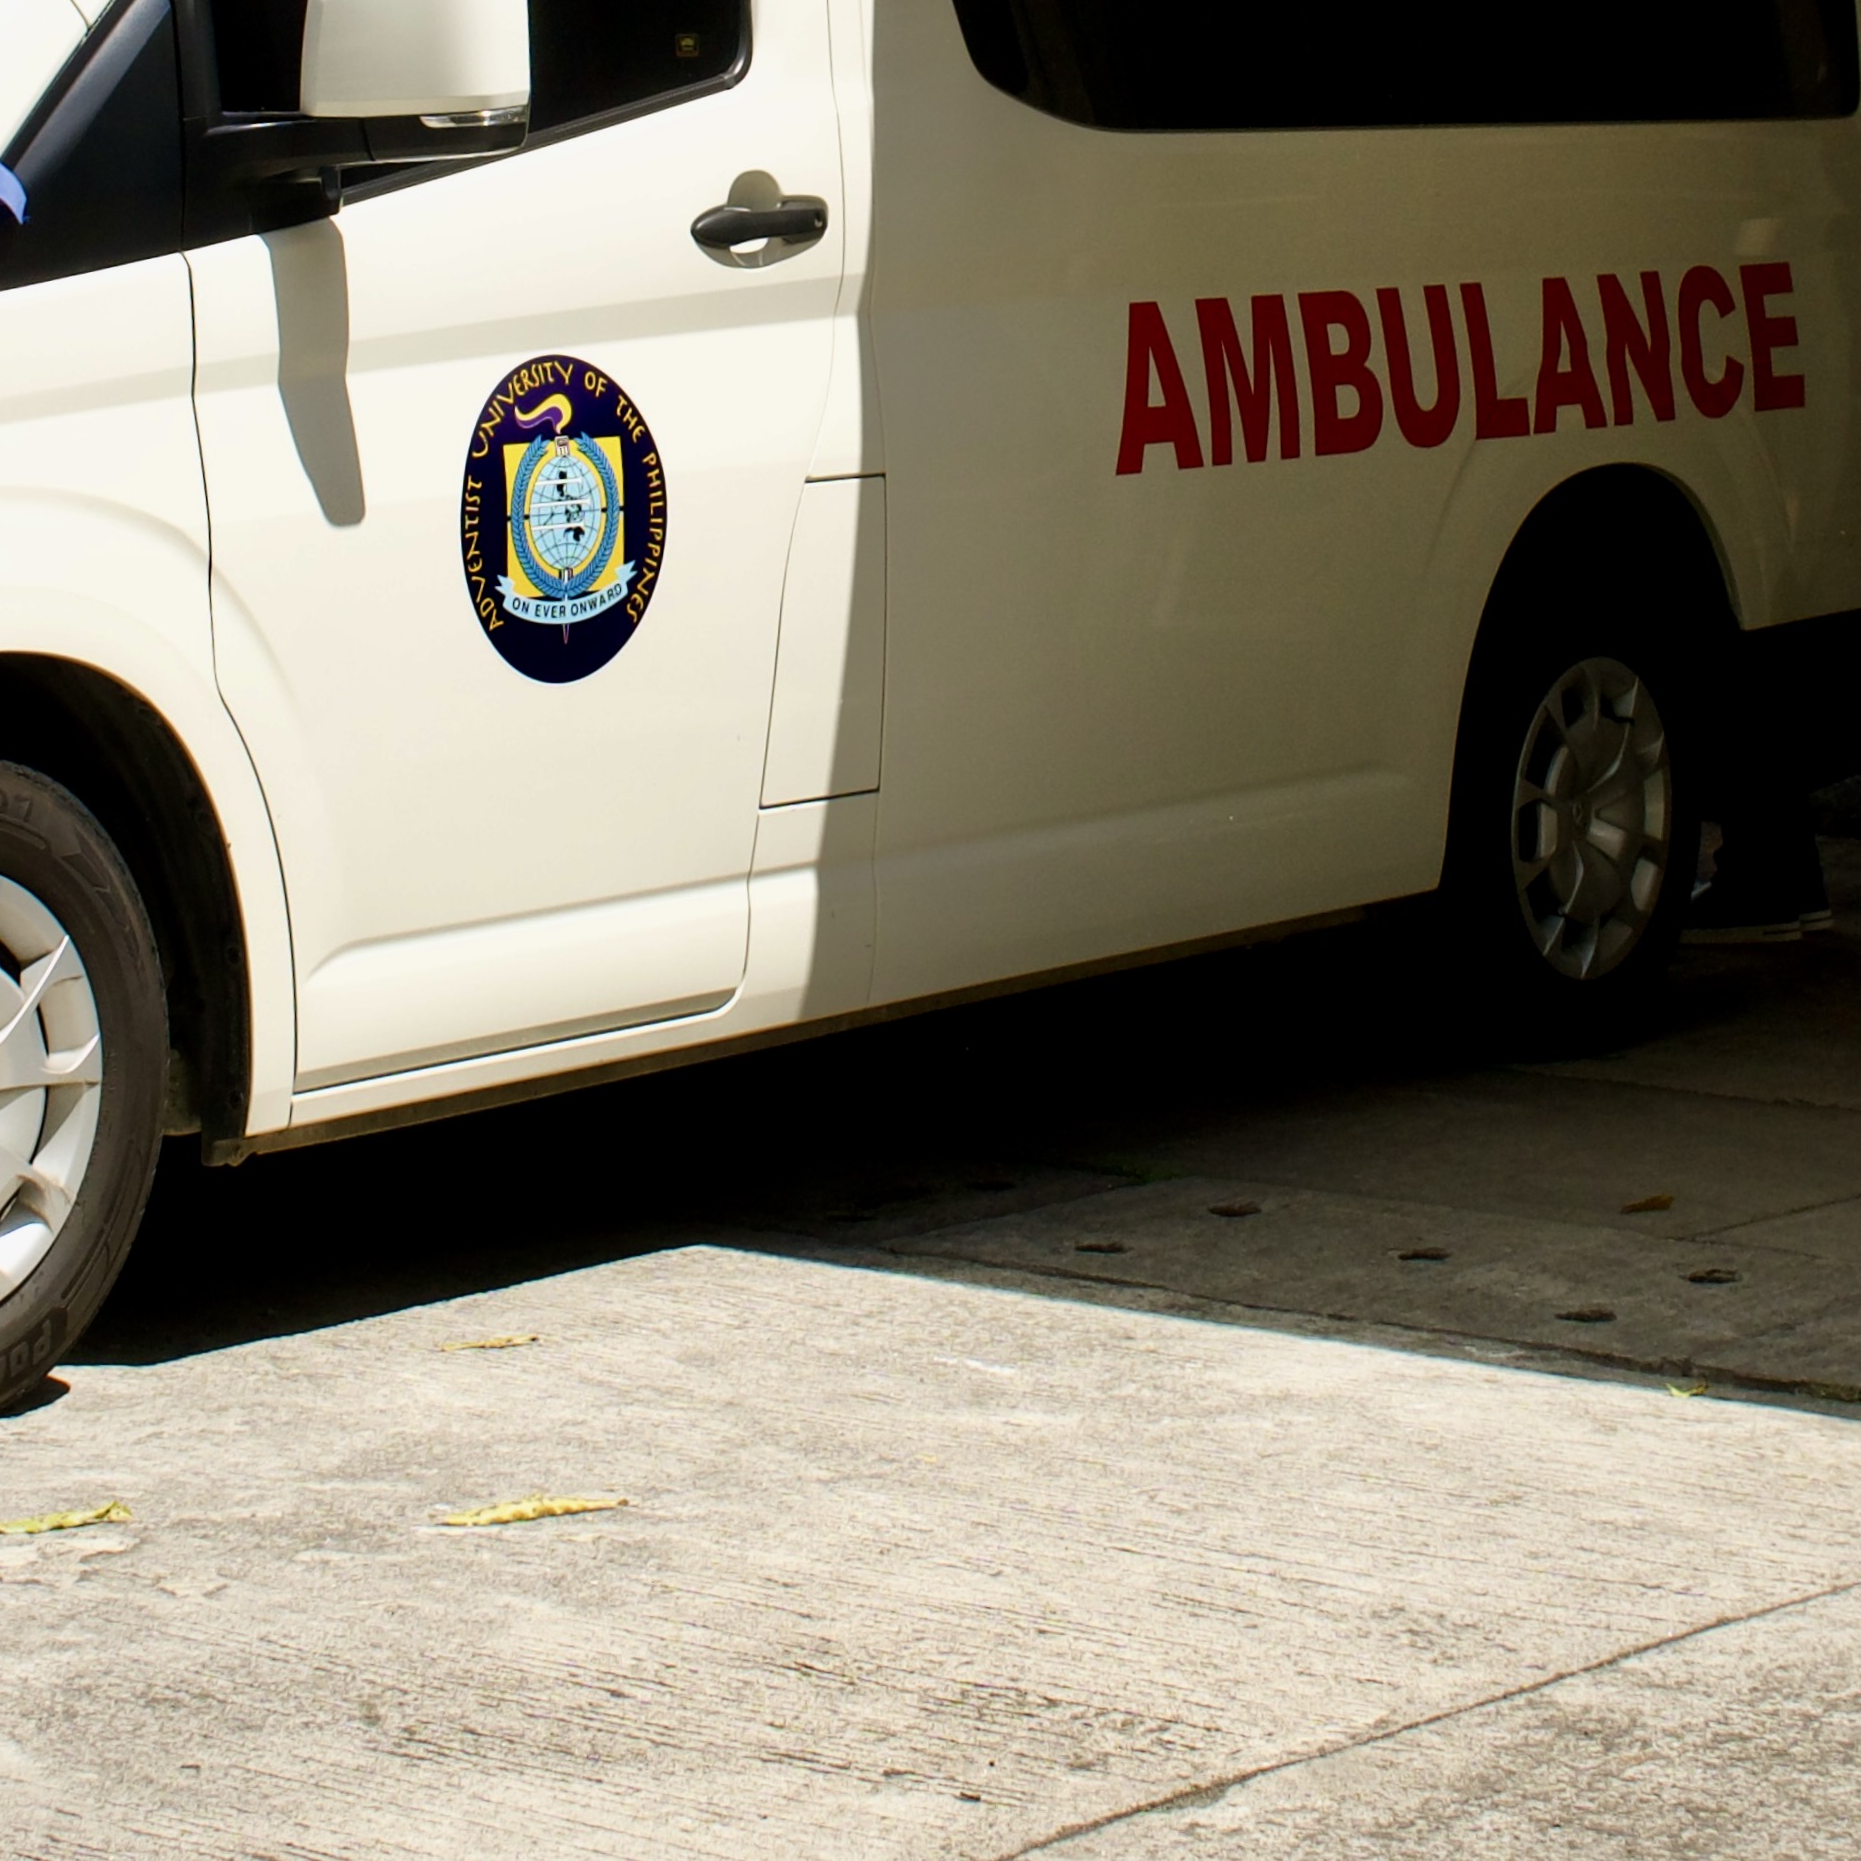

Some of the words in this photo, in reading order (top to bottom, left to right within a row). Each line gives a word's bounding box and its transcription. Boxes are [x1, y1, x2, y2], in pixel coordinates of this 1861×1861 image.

[472, 361, 574, 459] UNIVERSITY
[584, 371, 608, 397] OF
[1115, 261, 1806, 476] AMBULANCE
[616, 395, 645, 443] THE
[465, 476, 504, 630] ADVENTIST
[627, 452, 663, 625] PHILIPPINES
[512, 596, 529, 614] ON
[535, 602, 567, 619] EVER
[570, 584, 623, 617] ONWARD
